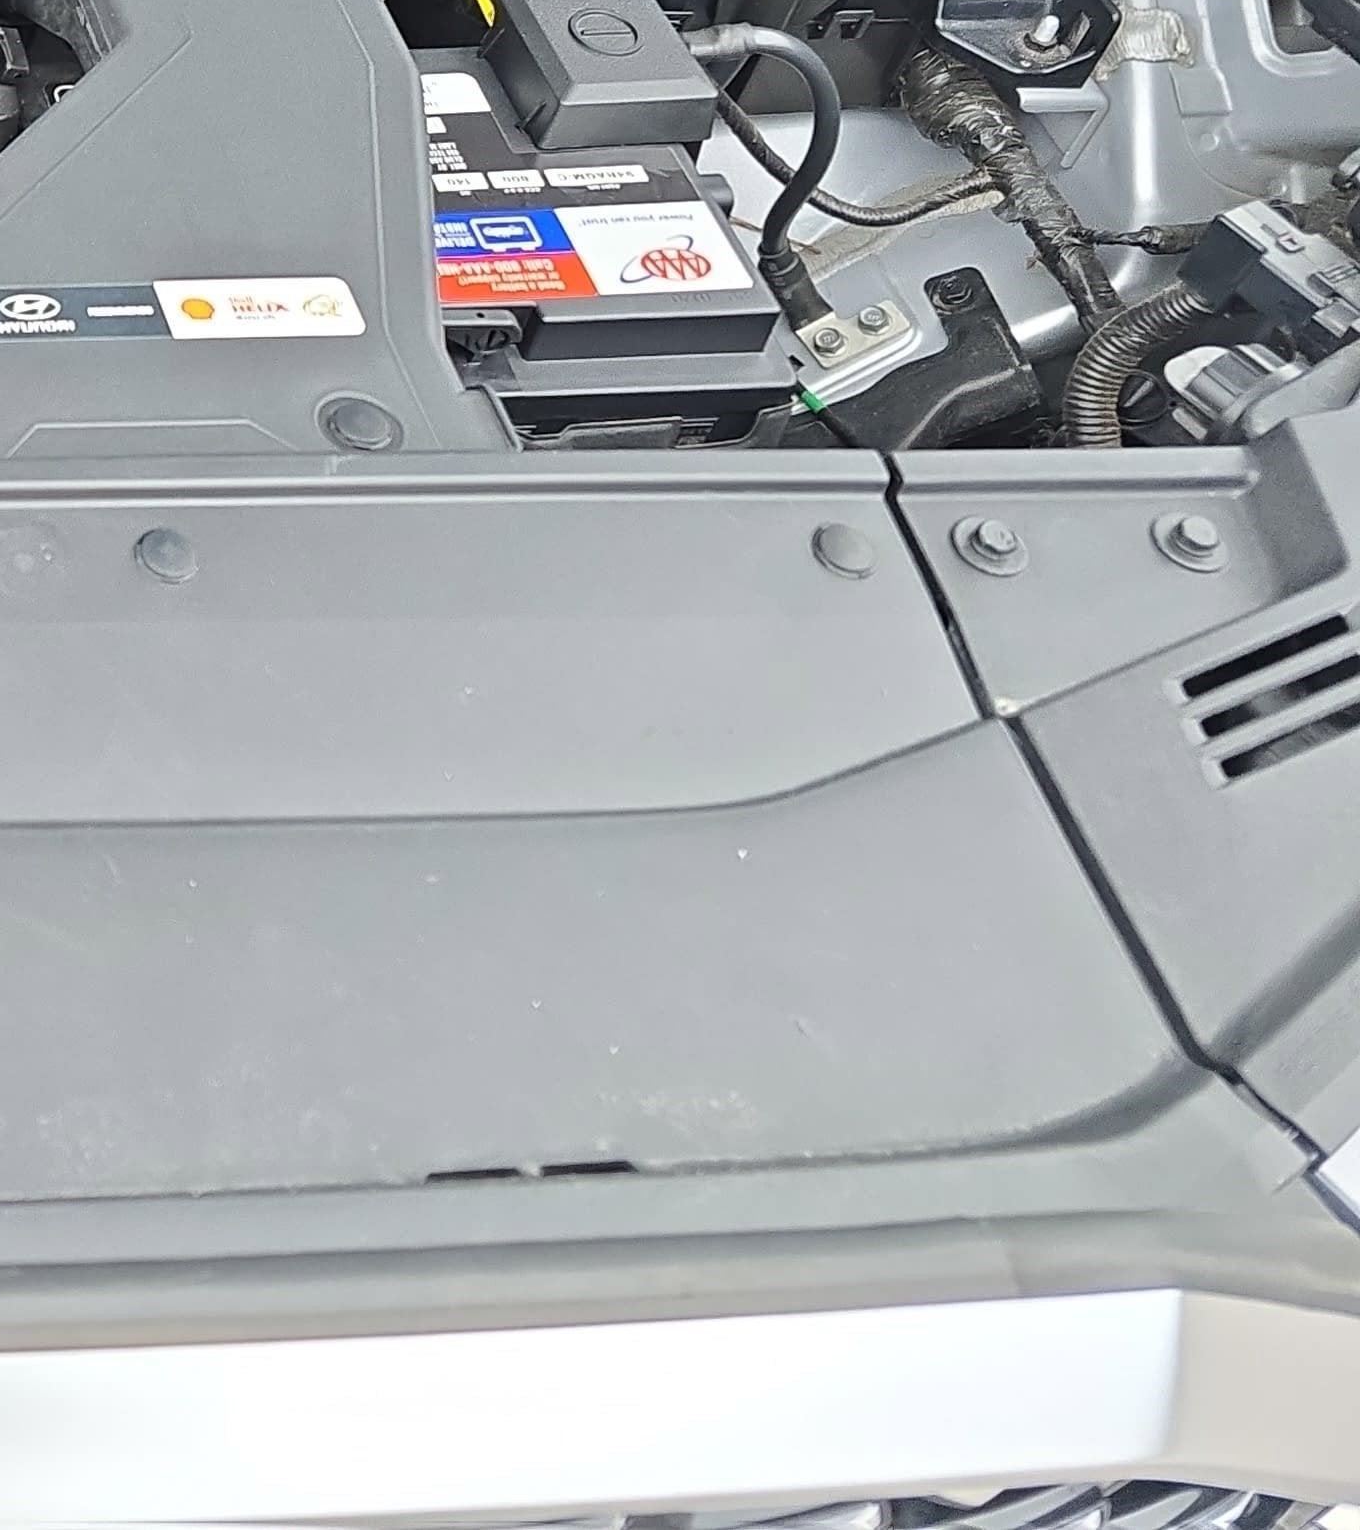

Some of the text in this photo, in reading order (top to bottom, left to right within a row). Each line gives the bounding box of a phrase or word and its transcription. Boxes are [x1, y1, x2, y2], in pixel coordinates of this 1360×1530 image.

[610, 215, 630, 223] can
[633, 212, 655, 223] you
[658, 213, 693, 222] Power
